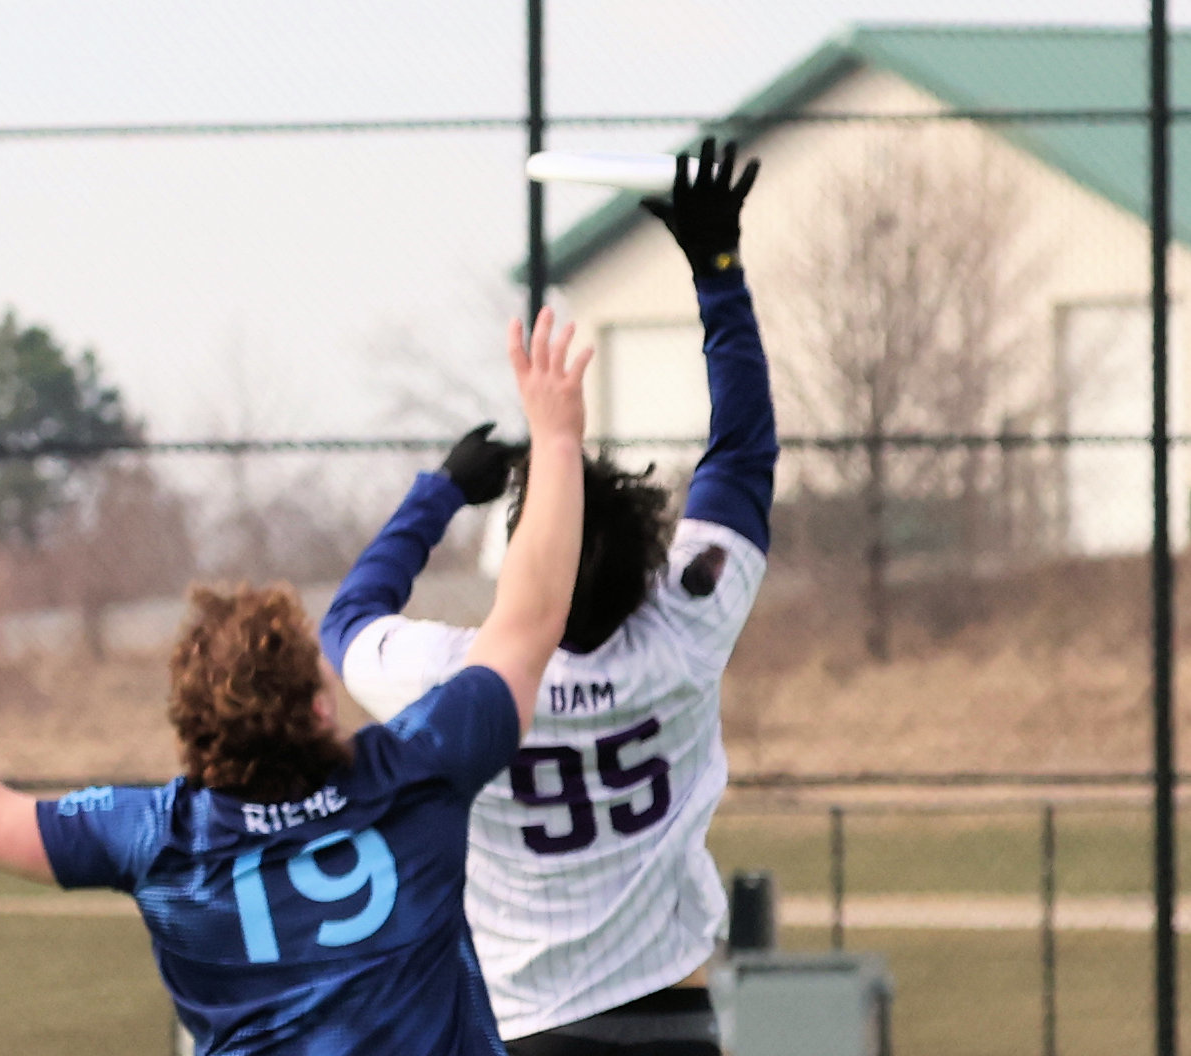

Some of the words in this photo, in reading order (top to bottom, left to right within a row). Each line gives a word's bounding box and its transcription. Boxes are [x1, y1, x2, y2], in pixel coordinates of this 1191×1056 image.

[550, 681, 615, 715] DAM
[510, 717, 671, 856] 95
[232, 828, 398, 963] 19
